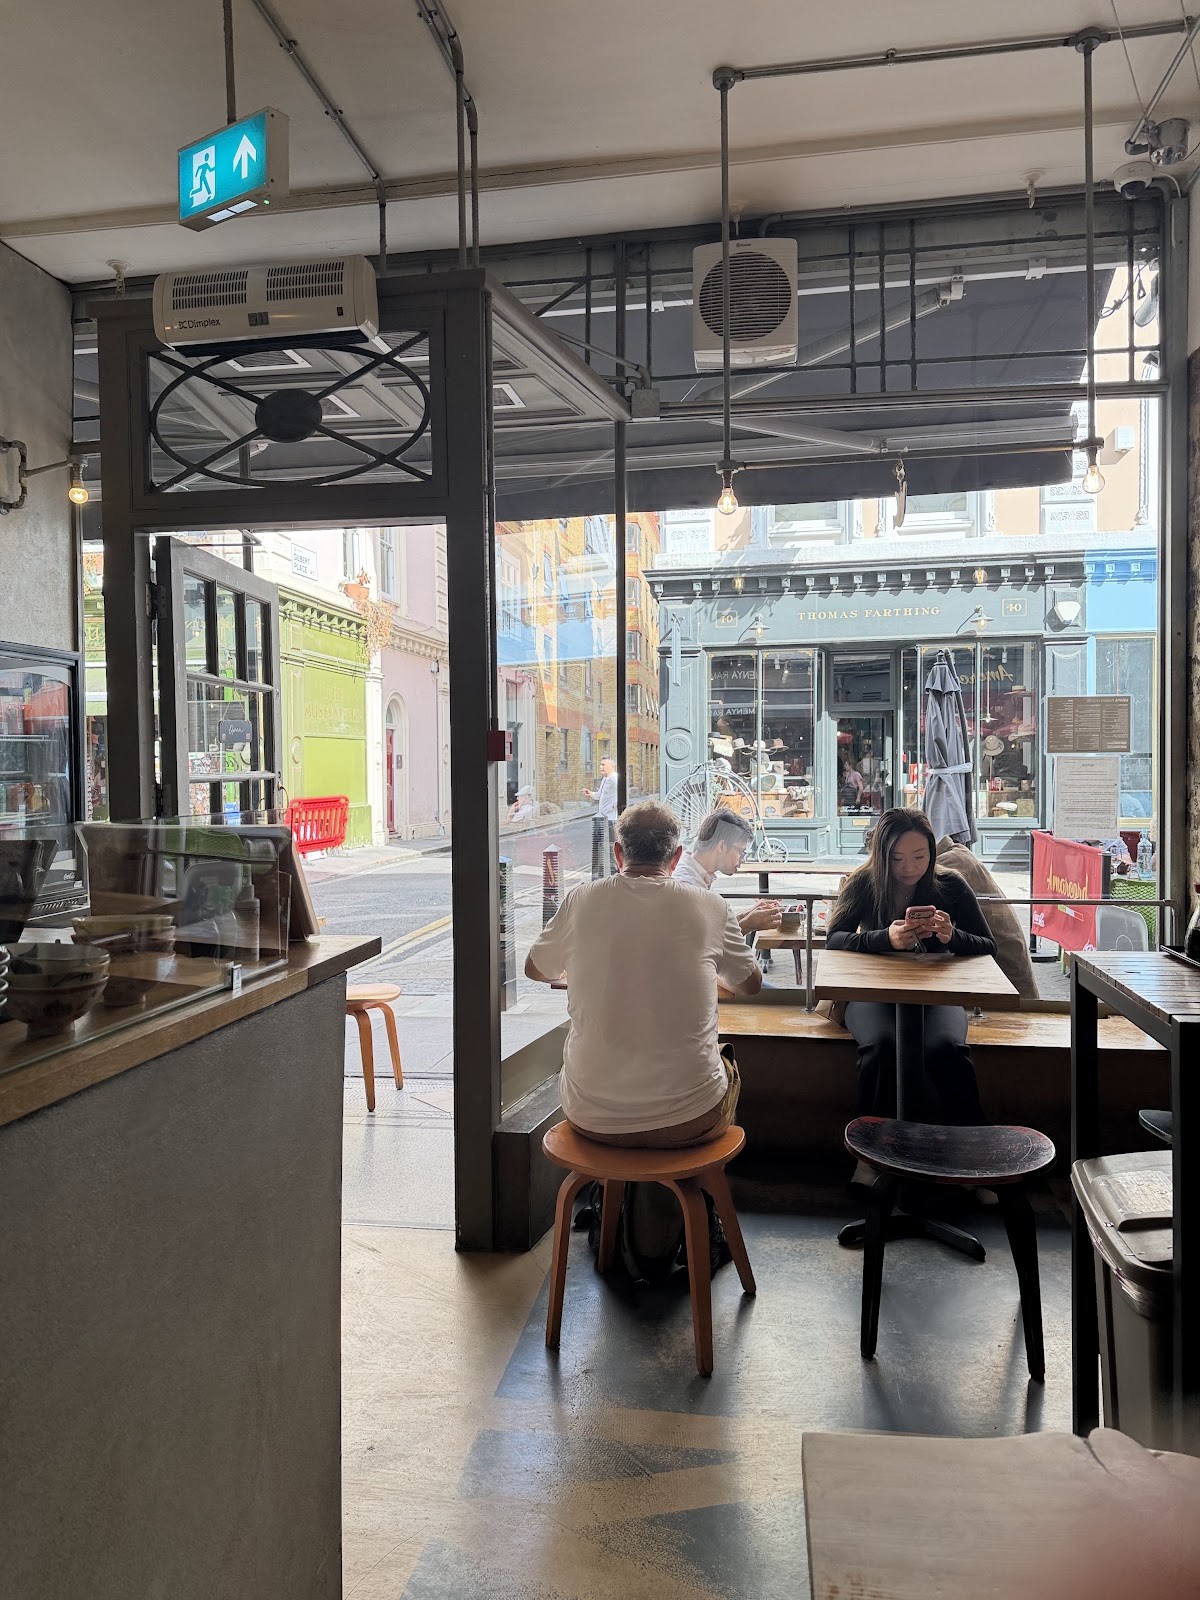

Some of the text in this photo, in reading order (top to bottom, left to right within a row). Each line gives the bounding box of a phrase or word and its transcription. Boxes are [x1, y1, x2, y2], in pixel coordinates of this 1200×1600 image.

[187, 318, 221, 329] Dimplex
[1006, 602, 1022, 612] 40
[797, 606, 941, 622] THOMAS FARTHING
[228, 724, 244, 735] Open
